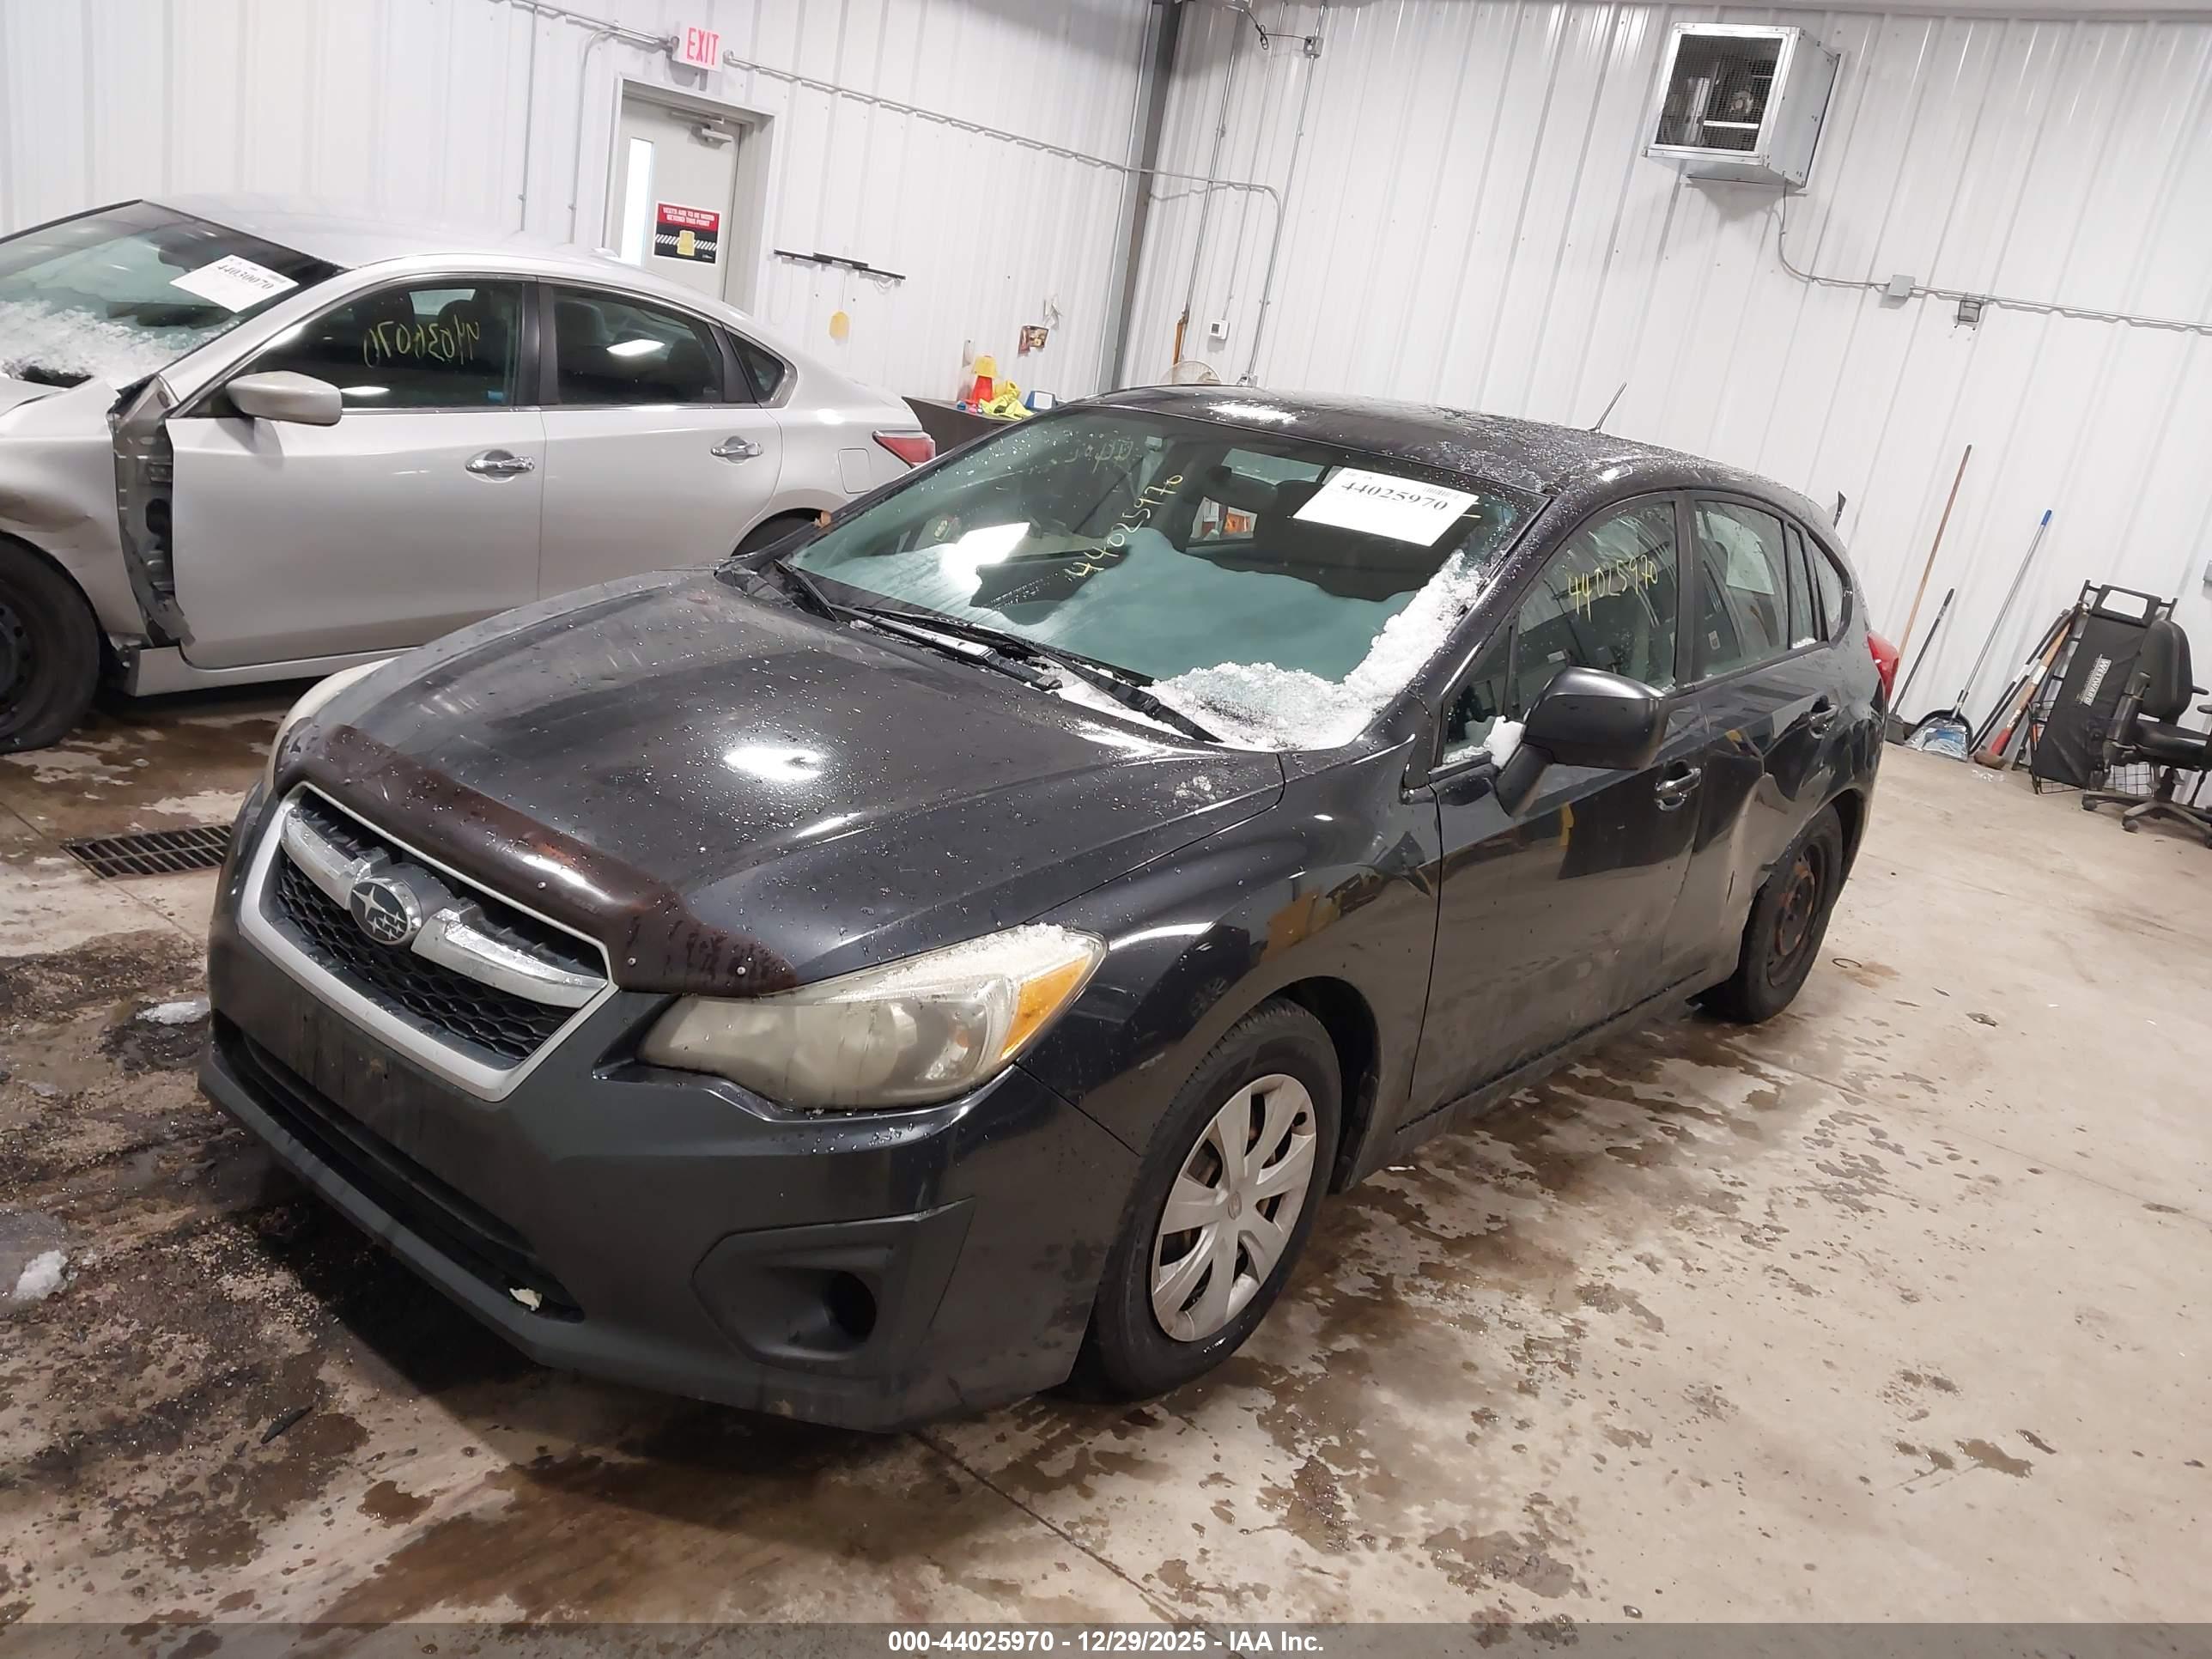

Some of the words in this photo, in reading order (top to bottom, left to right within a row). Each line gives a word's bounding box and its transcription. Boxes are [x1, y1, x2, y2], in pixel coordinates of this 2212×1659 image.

[687, 27, 720, 65] EXIT
[1340, 481, 1449, 511] 44025970
[1063, 474, 1183, 580] 44025970
[2086, 658, 2112, 705] WESTWARD
